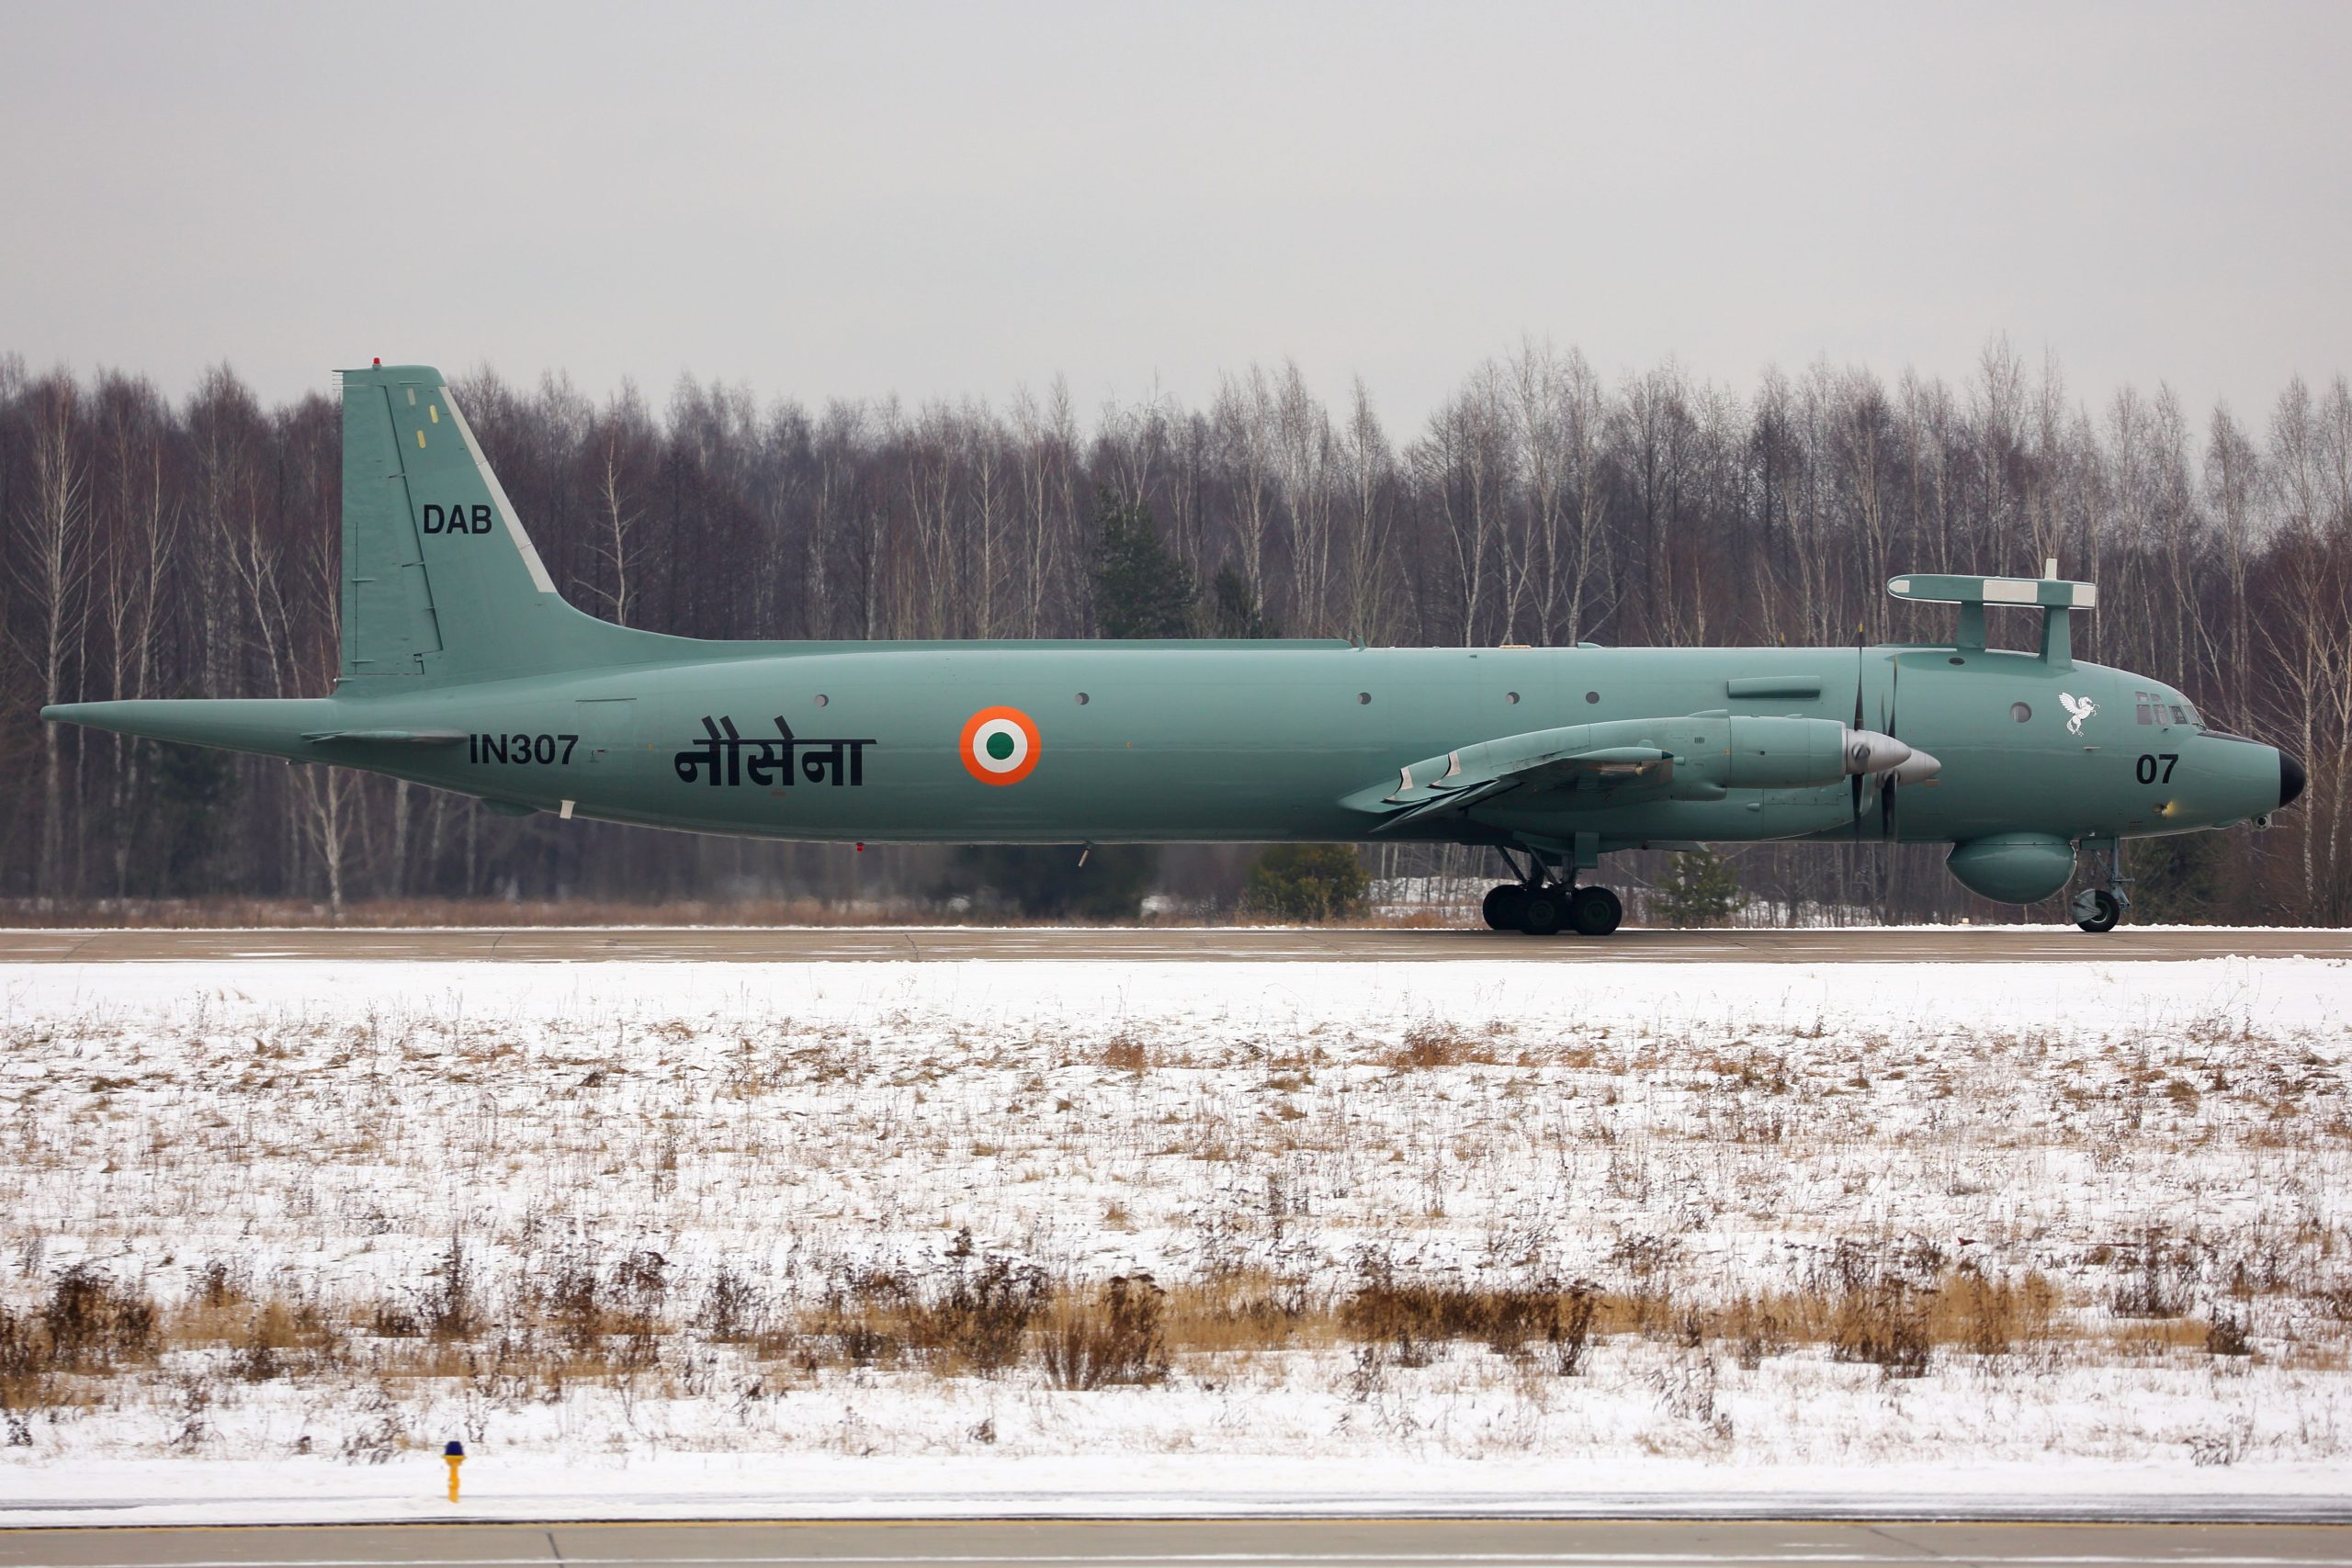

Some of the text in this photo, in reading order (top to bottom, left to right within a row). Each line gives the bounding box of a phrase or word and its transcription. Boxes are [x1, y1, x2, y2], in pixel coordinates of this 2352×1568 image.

[424, 504, 492, 535] DAB
[469, 734, 579, 765] IN307
[673, 715, 877, 787] नौसेना
[2135, 753, 2179, 785] 07
